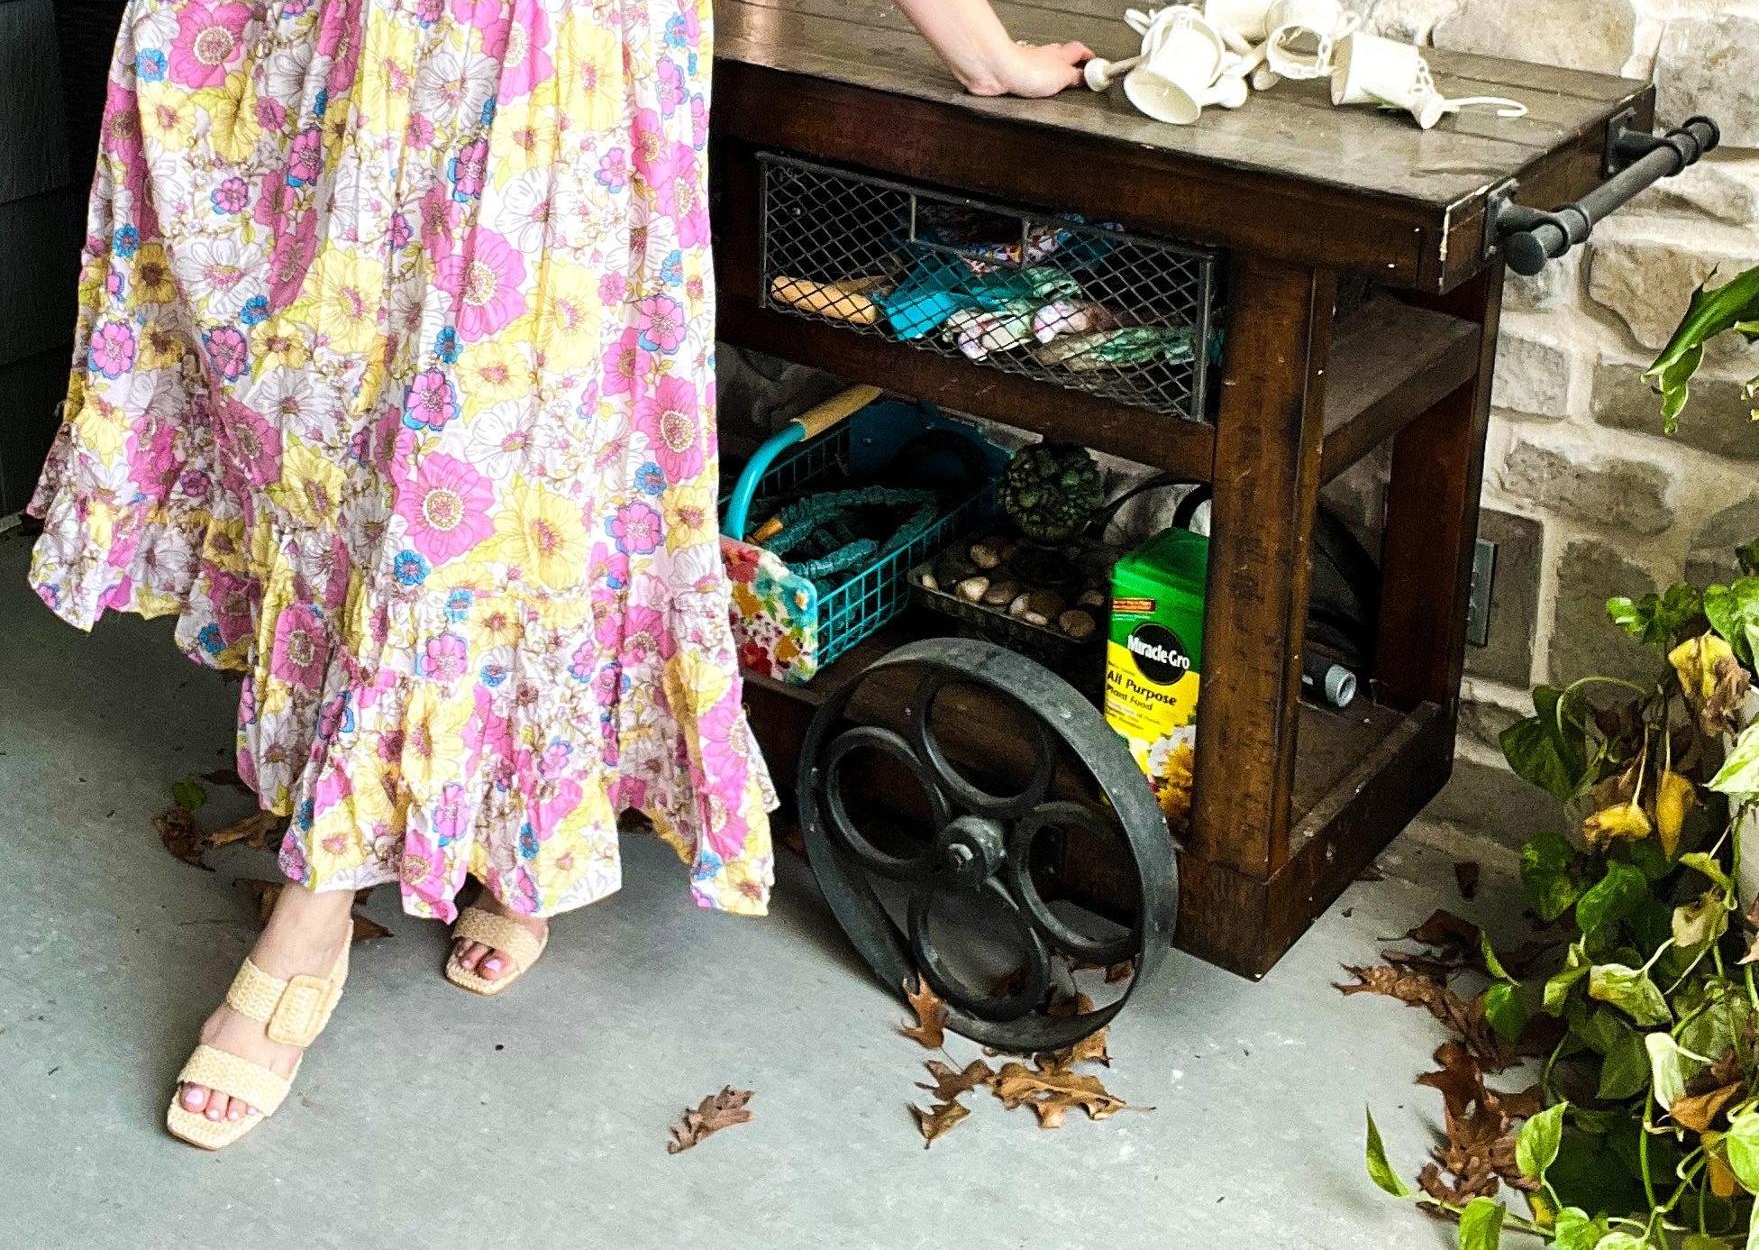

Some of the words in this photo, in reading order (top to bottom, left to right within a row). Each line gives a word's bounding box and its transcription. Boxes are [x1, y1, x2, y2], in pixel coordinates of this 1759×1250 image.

[1106, 683, 1128, 700] Plant
[1130, 696, 1153, 711] Food
[1107, 670, 1122, 685] All
[1126, 678, 1177, 706] Purpose
